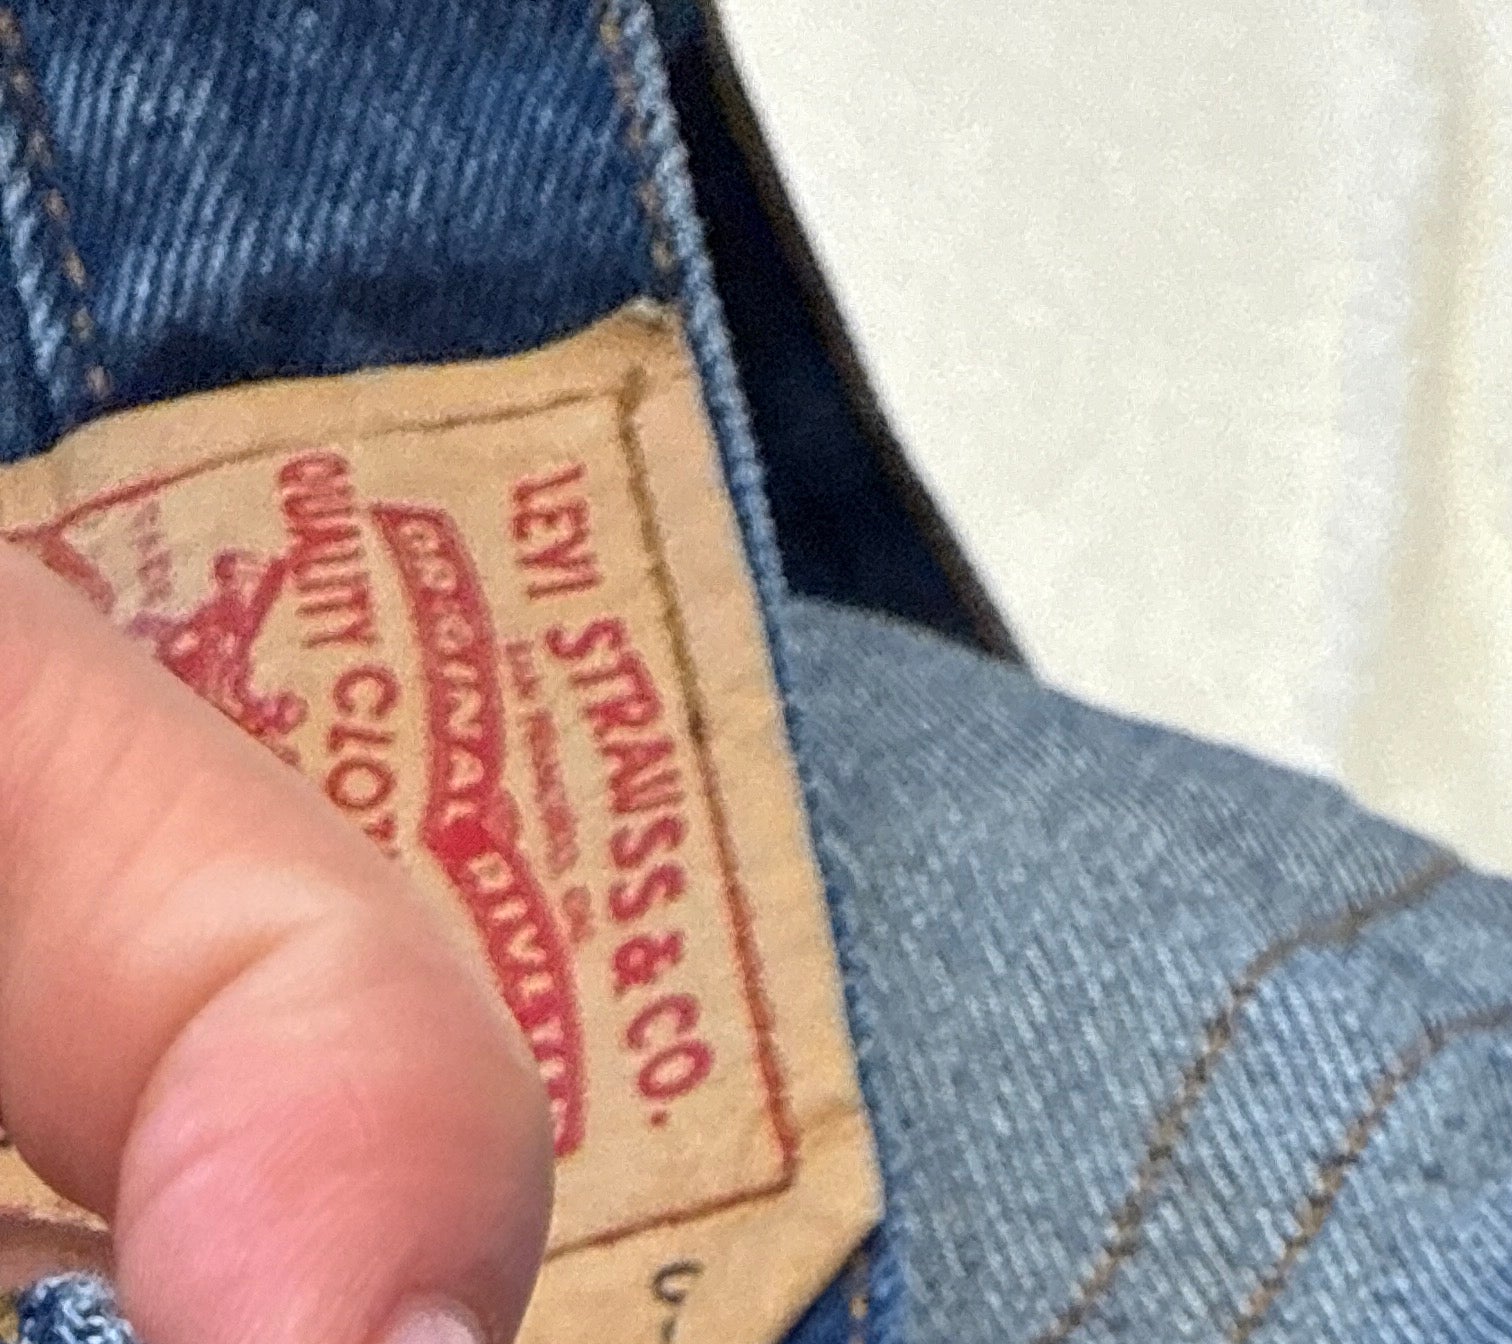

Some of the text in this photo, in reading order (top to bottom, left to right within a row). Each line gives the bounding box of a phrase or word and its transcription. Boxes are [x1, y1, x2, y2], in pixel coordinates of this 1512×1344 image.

[279, 452, 378, 649] QUALITY
[512, 463, 602, 600] LEVI
[546, 616, 688, 922] STRAUSS
[612, 929, 686, 998] &
[626, 992, 719, 1130] CO.
